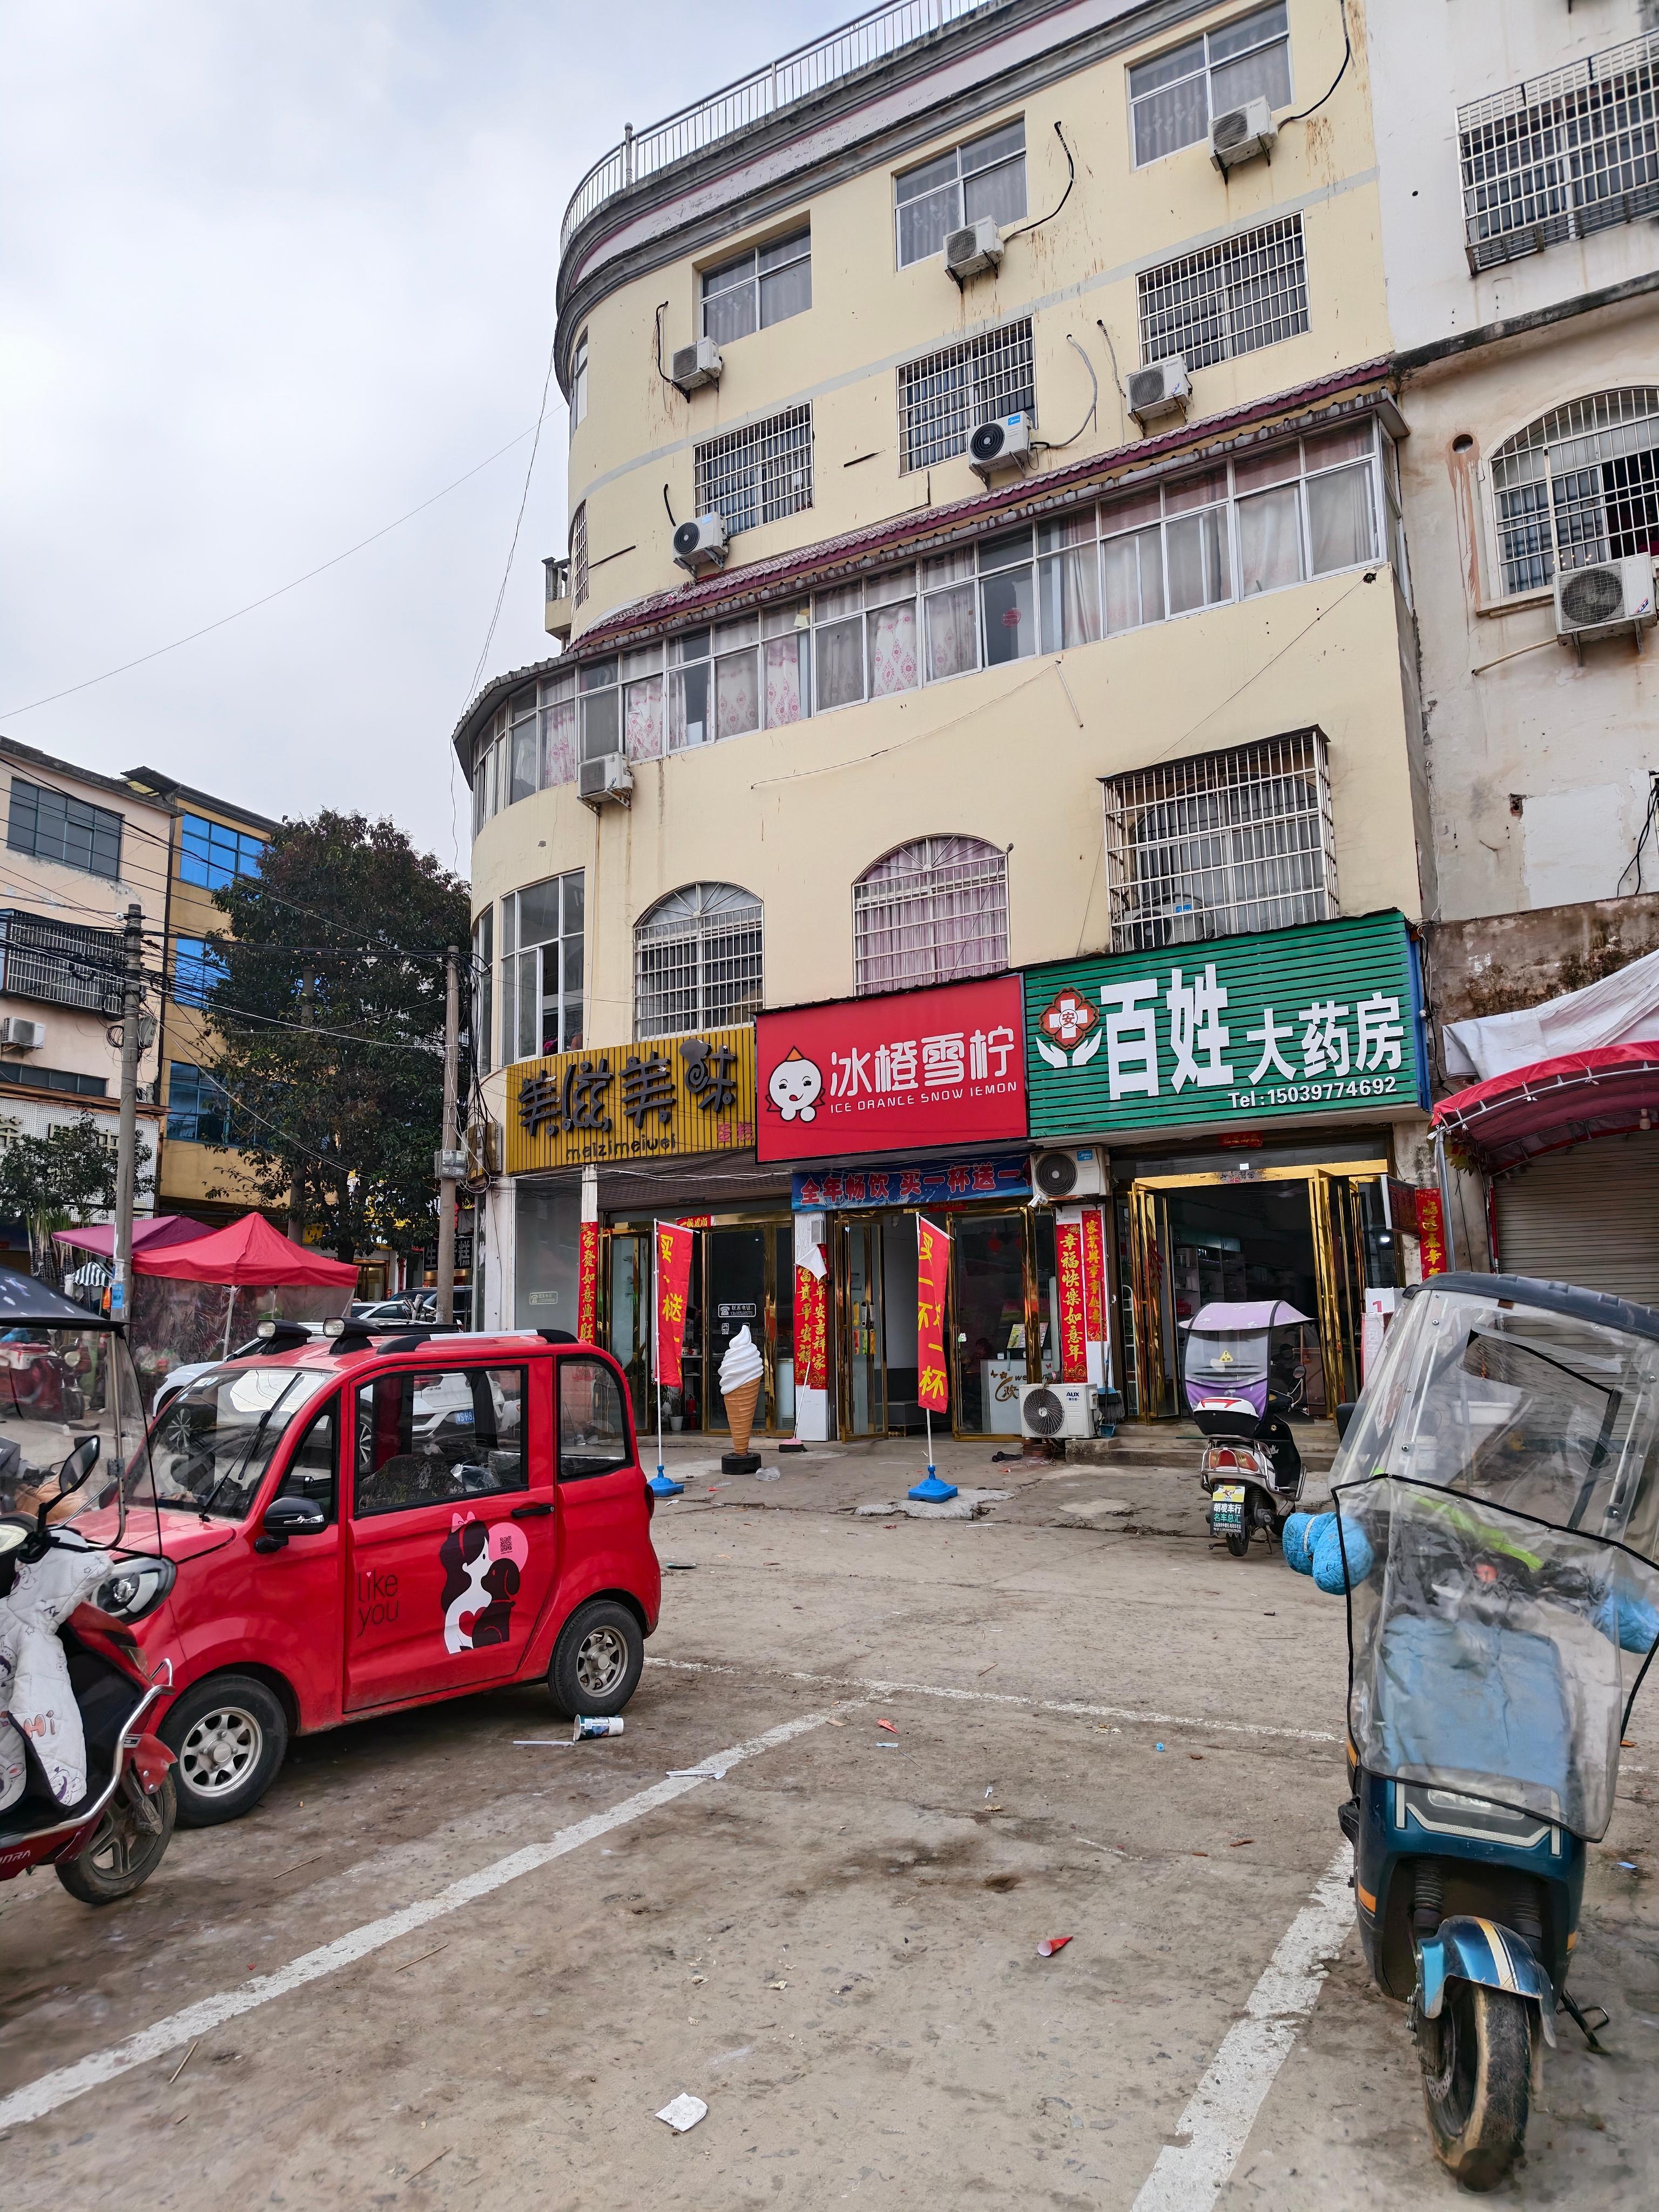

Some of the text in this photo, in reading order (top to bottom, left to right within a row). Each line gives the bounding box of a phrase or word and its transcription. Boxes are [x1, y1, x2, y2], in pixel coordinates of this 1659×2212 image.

[1062, 1011, 1075, 1026] 安
[1101, 963, 1404, 1101] 百姓大药房
[830, 1025, 1015, 1097] 冰橙雪柠
[518, 1038, 738, 1137] 美滋美味
[830, 1103, 852, 1114] ICE
[921, 1088, 963, 1103] SNOW
[800, 1158, 1031, 1205] 全年畅饮 买一杯送一
[359, 1569, 398, 1602] like
[356, 1600, 399, 1638] you
[24, 1710, 56, 1739] Hi
